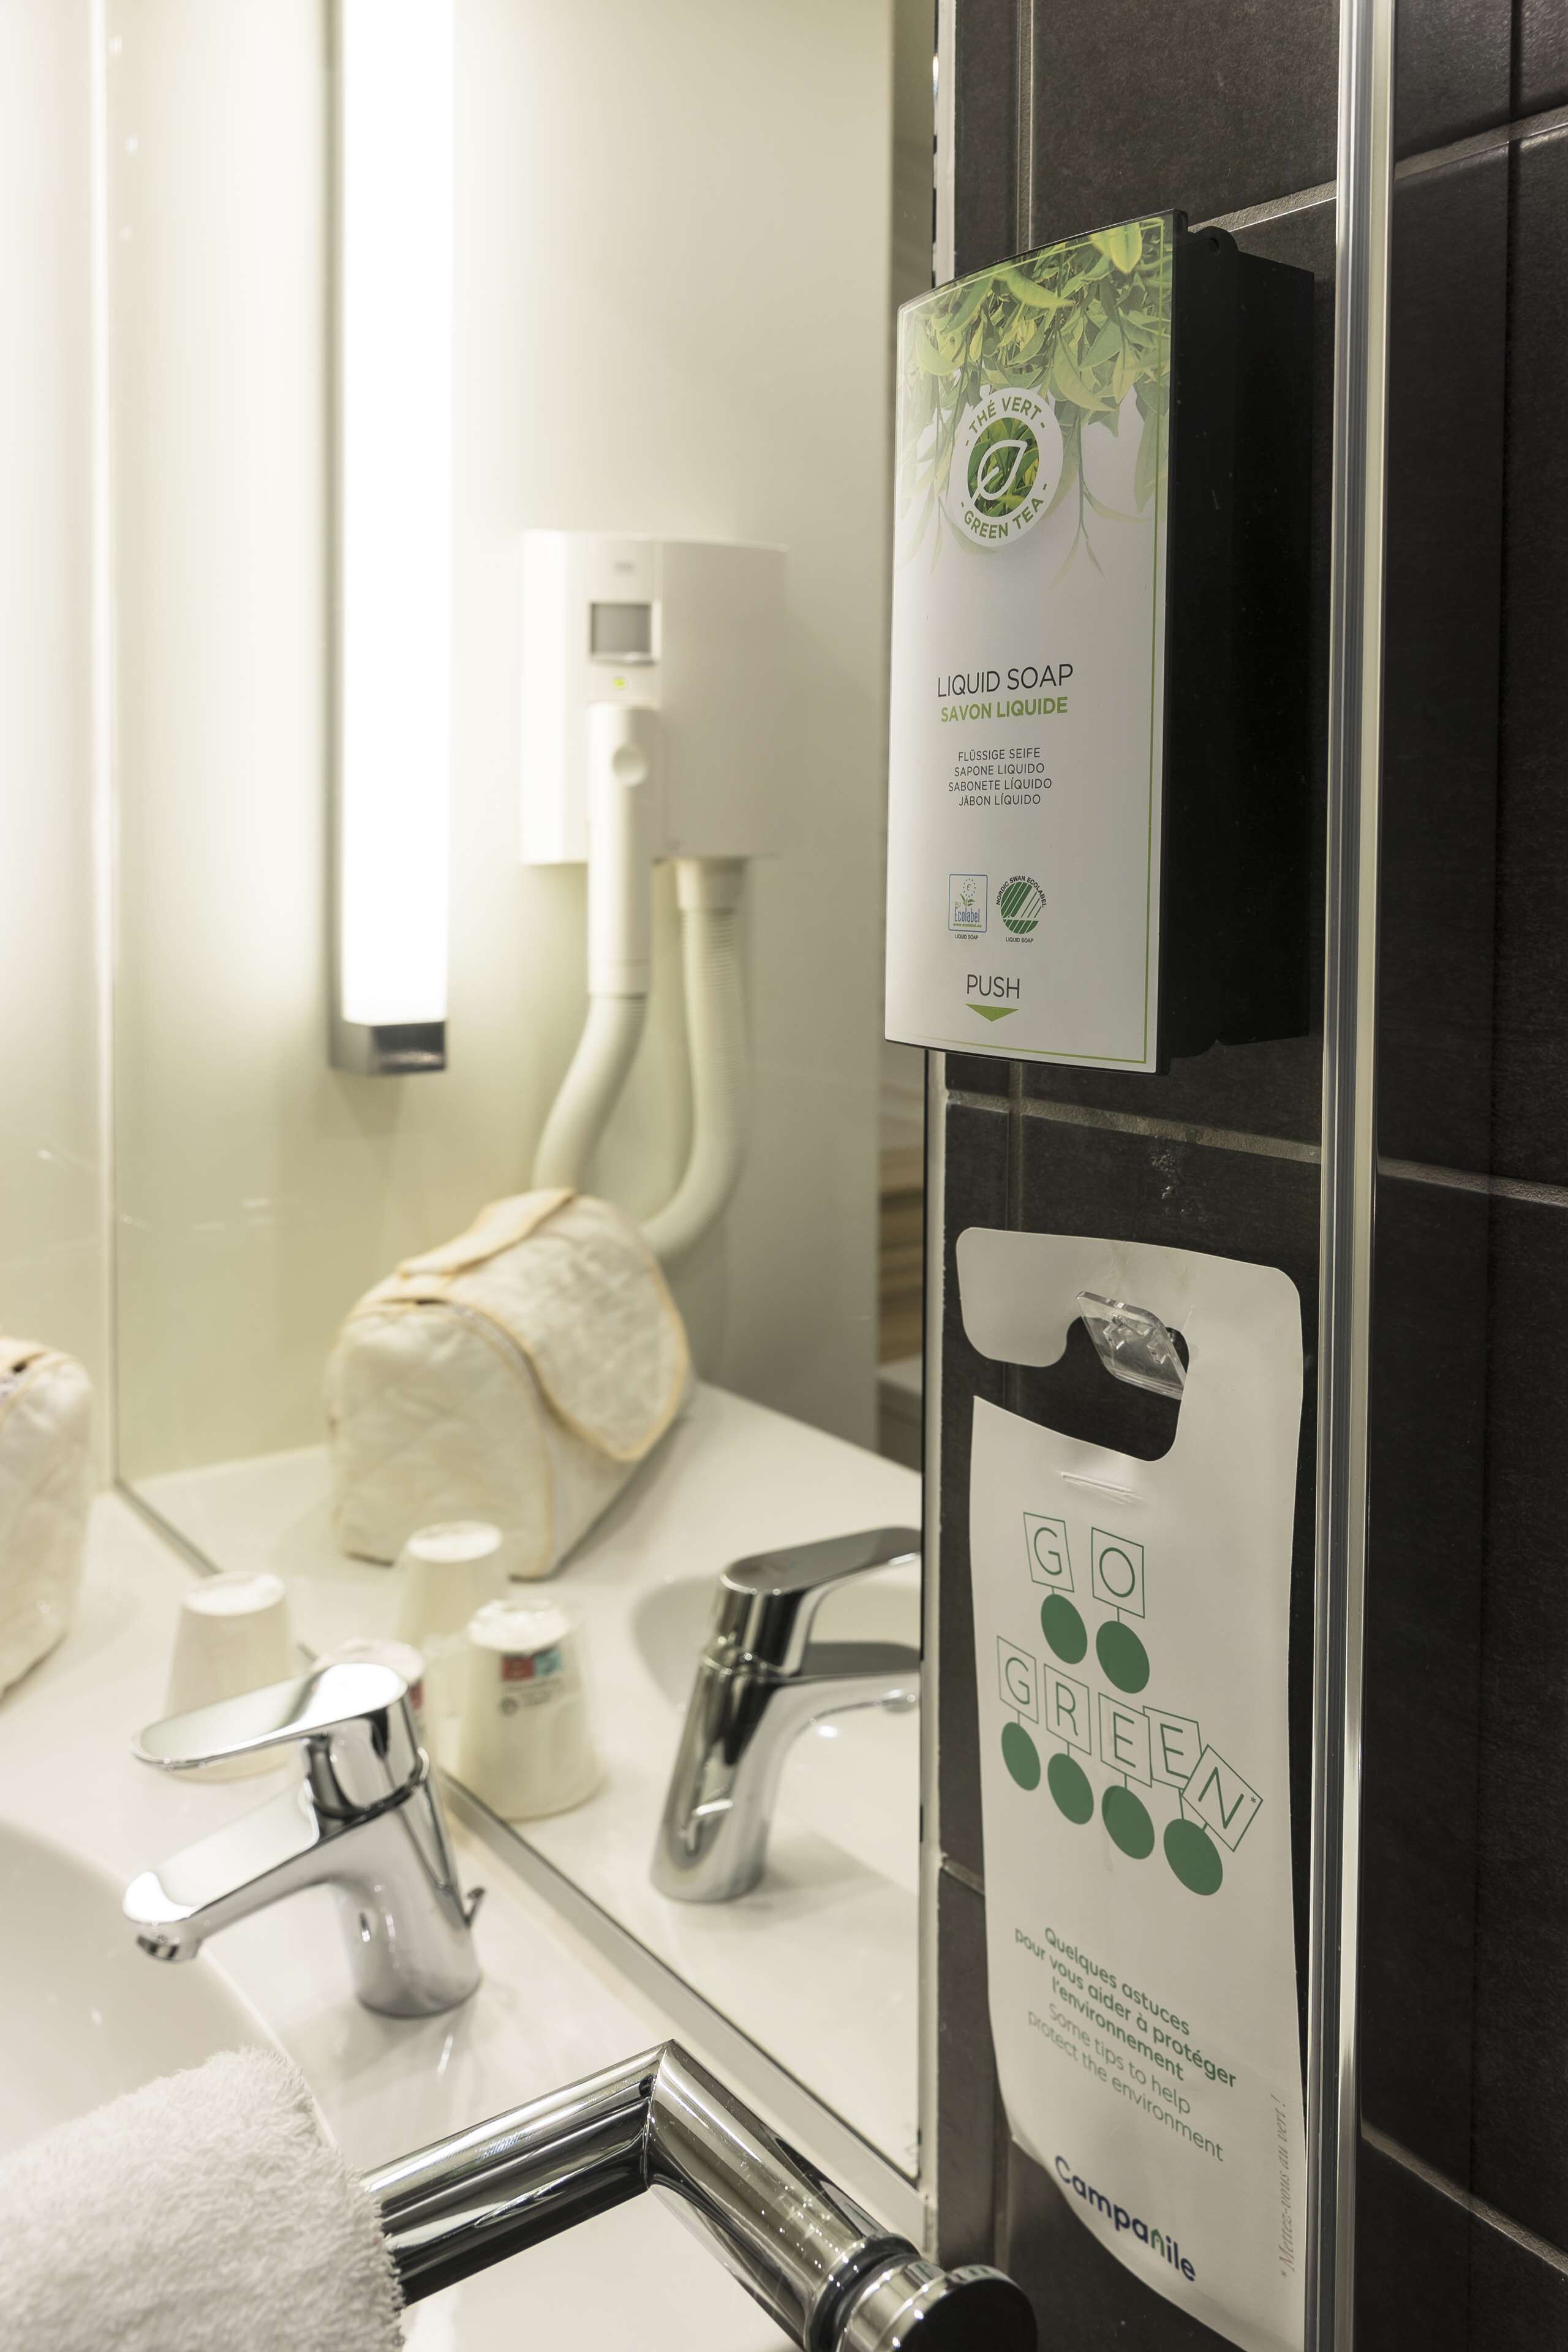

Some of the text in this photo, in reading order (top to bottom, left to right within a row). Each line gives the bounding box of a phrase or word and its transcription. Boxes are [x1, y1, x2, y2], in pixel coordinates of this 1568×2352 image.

[969, 396, 1042, 434] THÉ VERT
[964, 497, 1044, 539] GREEN TEA
[938, 663, 1073, 697] LIQUID SOAP
[941, 696, 1068, 723] SAVON LIQUIDE
[954, 763, 1044, 777] SAPONE LIQUIDO
[959, 747, 1041, 761] FLÜSSIGE SEIFE
[948, 777, 1052, 792] SABONETE LÍQUIDO
[995, 793, 1041, 805] LÍQUIDO
[996, 881, 1009, 905] NORDIC
[1027, 877, 1047, 908] ECOLABEL
[955, 907, 980, 922] Ecolabel
[967, 974, 1020, 999] PUSH
[1044, 1927, 1190, 2035] Quelques astuces
[1015, 1928, 1236, 2087] pour vous aider à protéger
[1049, 2003, 1191, 2114] Some tips to help
[1028, 2011, 1224, 2162] protect the environment
[1274, 2108, 1287, 2142] vert
[1278, 2145, 1289, 2169] au
[1055, 2155, 1196, 2282] Campanile
